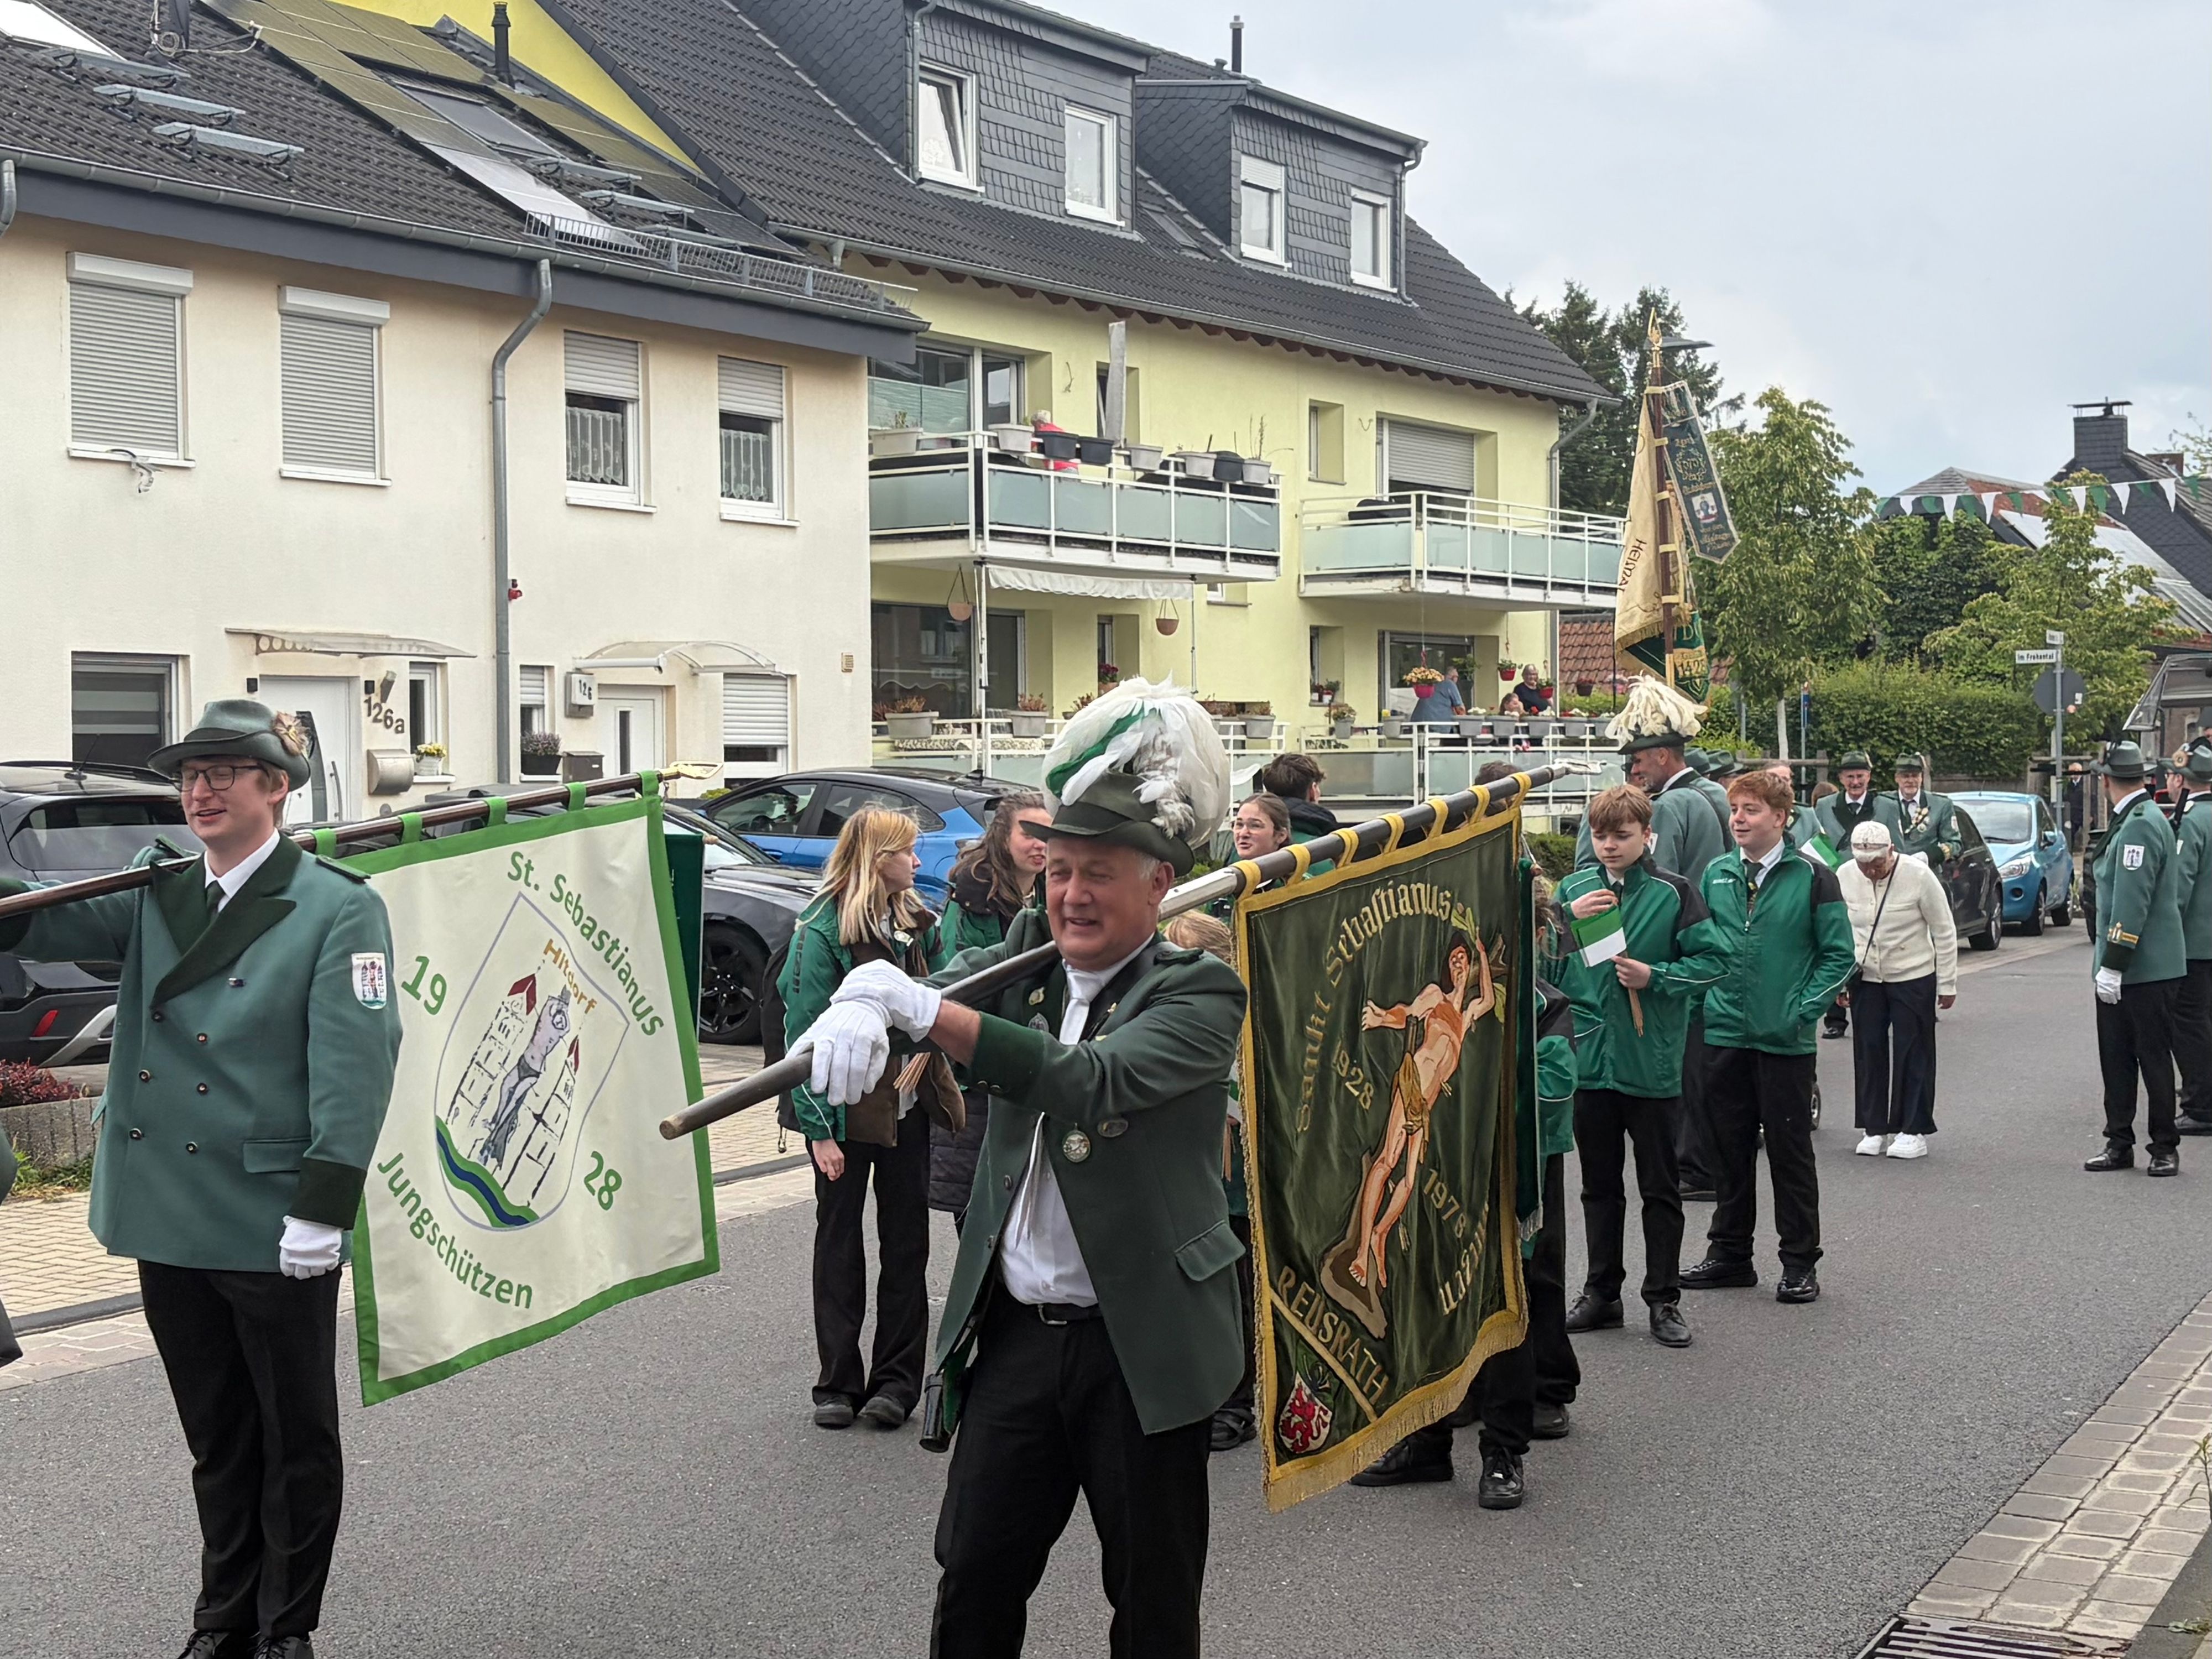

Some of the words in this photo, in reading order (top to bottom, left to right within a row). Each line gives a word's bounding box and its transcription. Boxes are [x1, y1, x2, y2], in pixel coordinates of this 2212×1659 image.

[364, 696, 405, 734] 126a
[579, 679, 592, 701] 126
[507, 851, 540, 891] St.
[550, 874, 664, 1036] Sebastianus
[401, 955, 447, 1015] 19
[583, 1150, 623, 1211] 28
[377, 1152, 533, 1310] Jungschützen
[1278, 1265, 1389, 1406] REUSRATH
